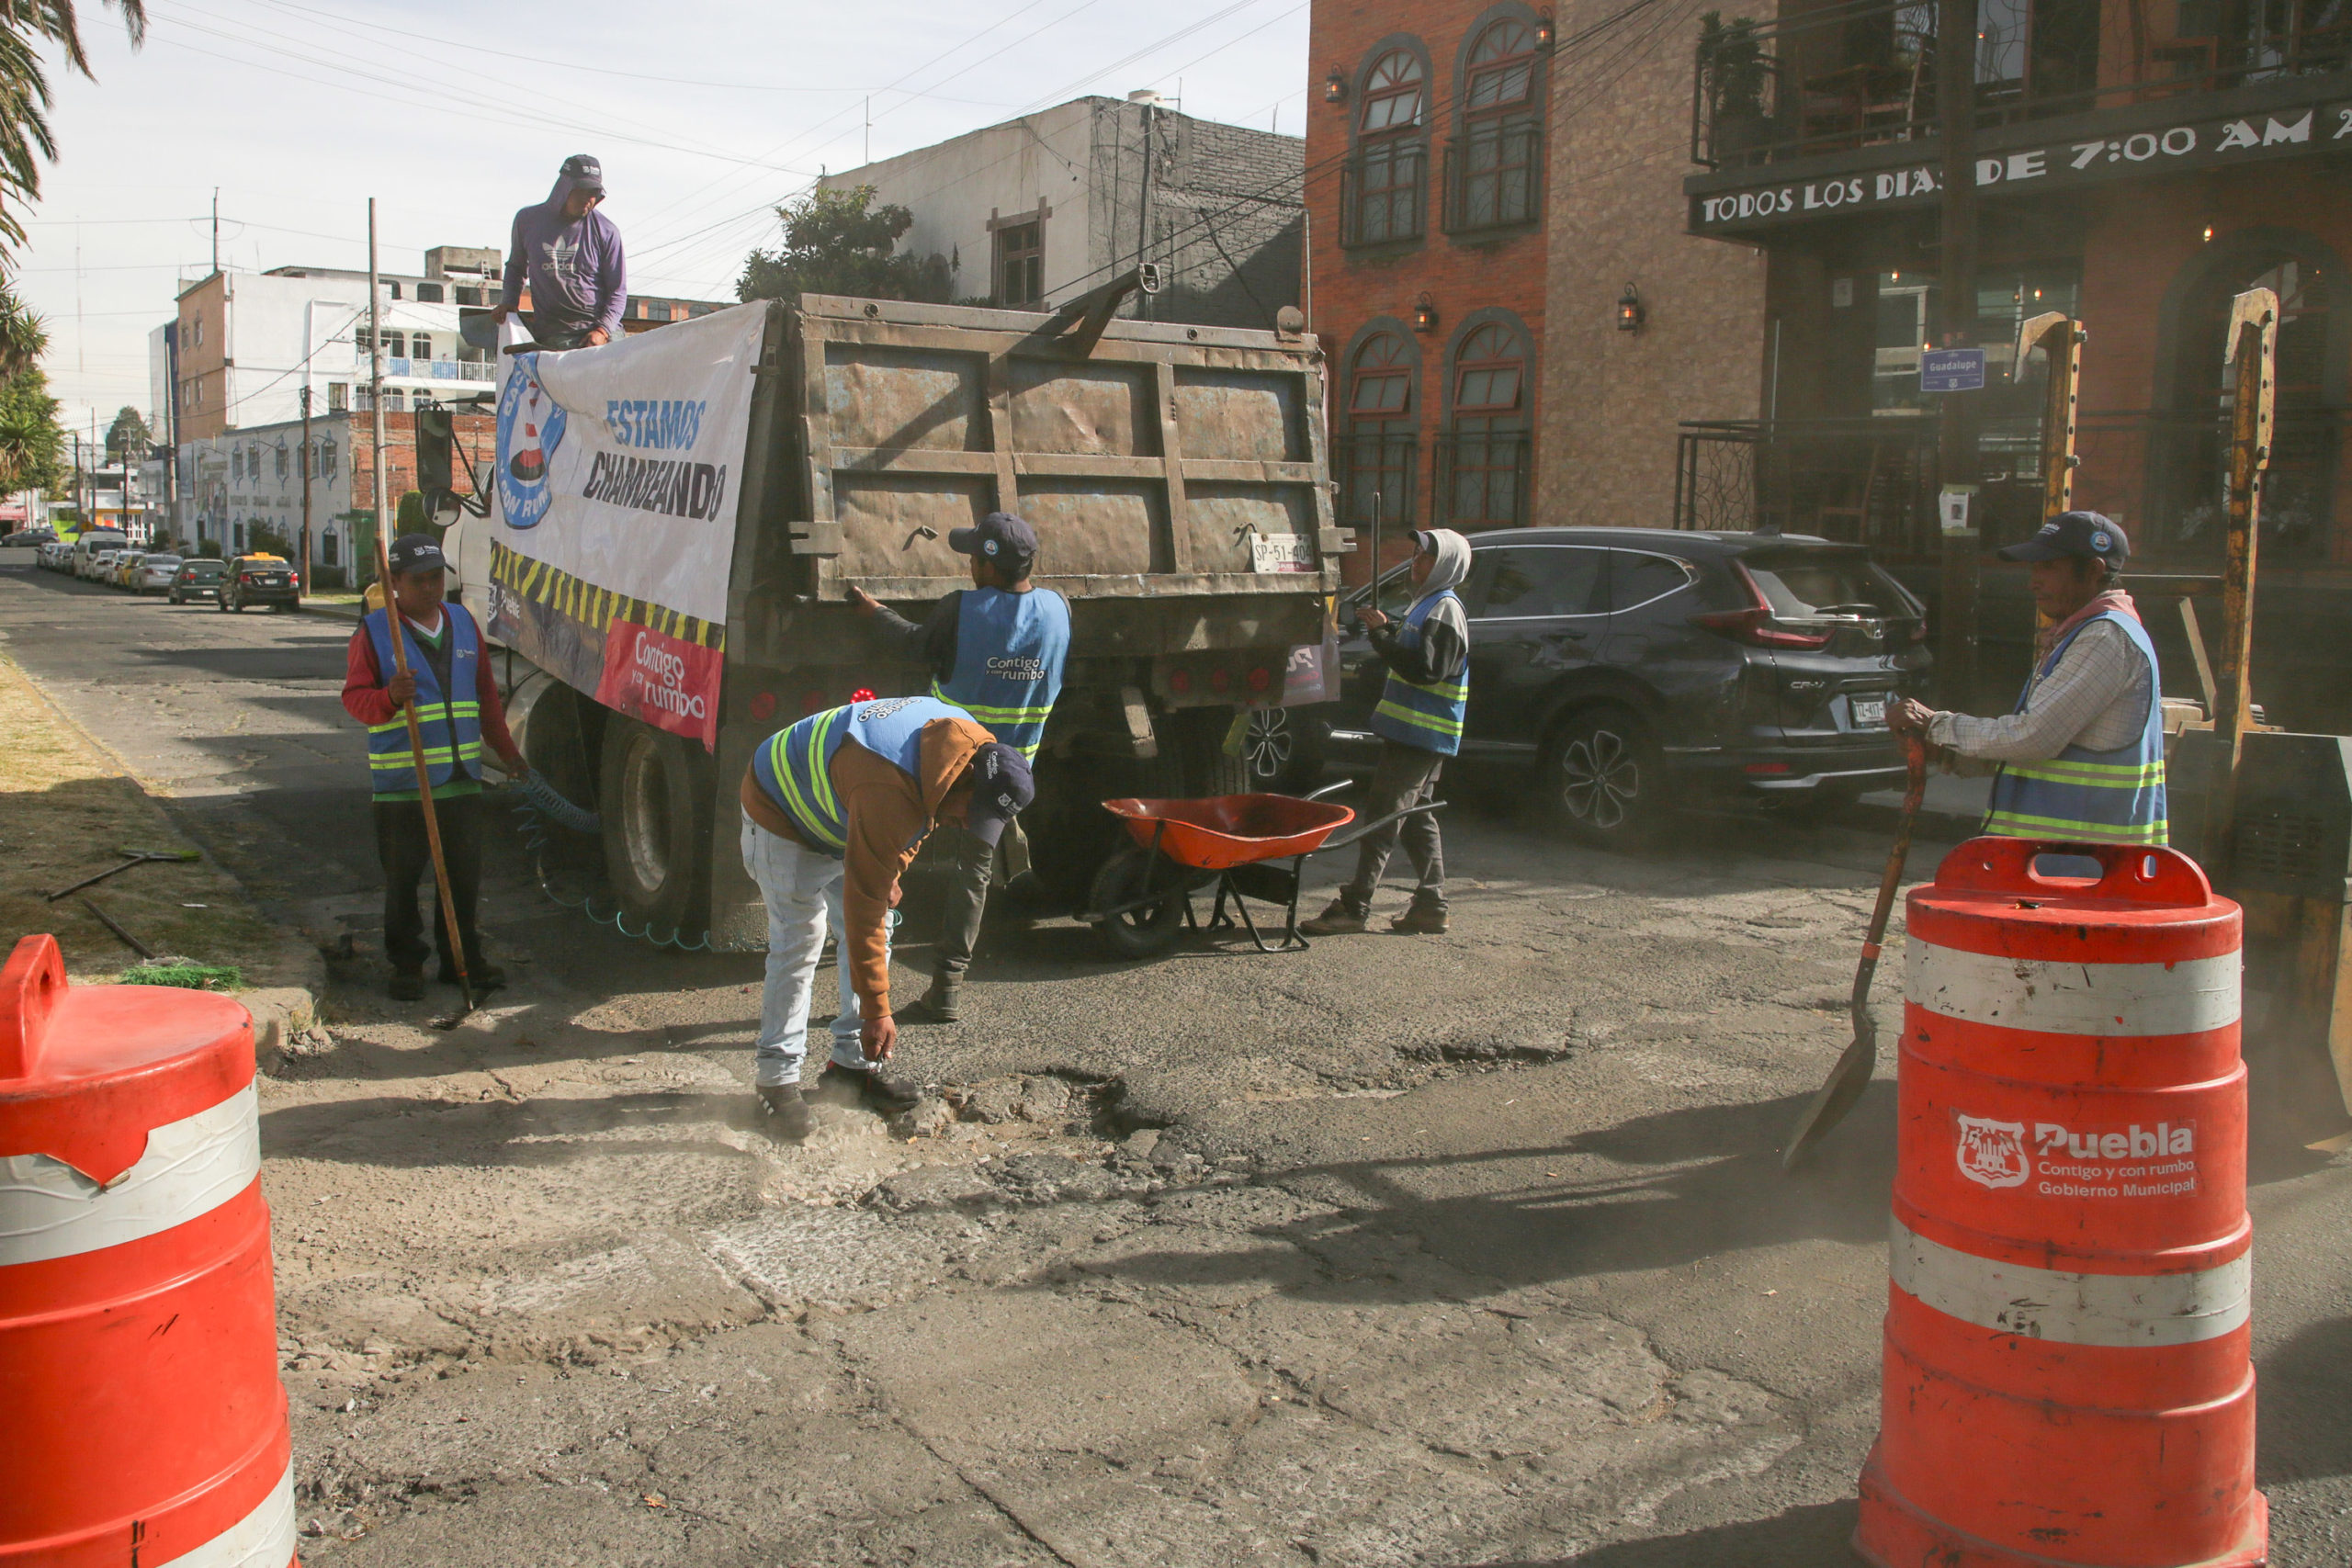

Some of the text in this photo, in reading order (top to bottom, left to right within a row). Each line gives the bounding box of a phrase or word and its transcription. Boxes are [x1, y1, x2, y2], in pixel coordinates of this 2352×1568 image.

[1702, 187, 1793, 221] TODOS
[1804, 178, 1864, 210] LOS
[1975, 150, 2047, 186] DE
[2070, 127, 2197, 170] 7:00
[2215, 109, 2313, 152] AM
[1929, 359, 1977, 372] Guadalupe
[605, 400, 707, 451] ESTAMOS
[635, 631, 685, 687] Contigo
[986, 656, 1040, 671] Contigo
[1002, 668, 1045, 681] rumbo
[645, 681, 706, 719] rumbo
[2035, 1122, 2193, 1160] Puebla
[2038, 1159, 2195, 1181] Contigo y con rumbo
[2038, 1177, 2195, 1198] Gobierno Municipal
